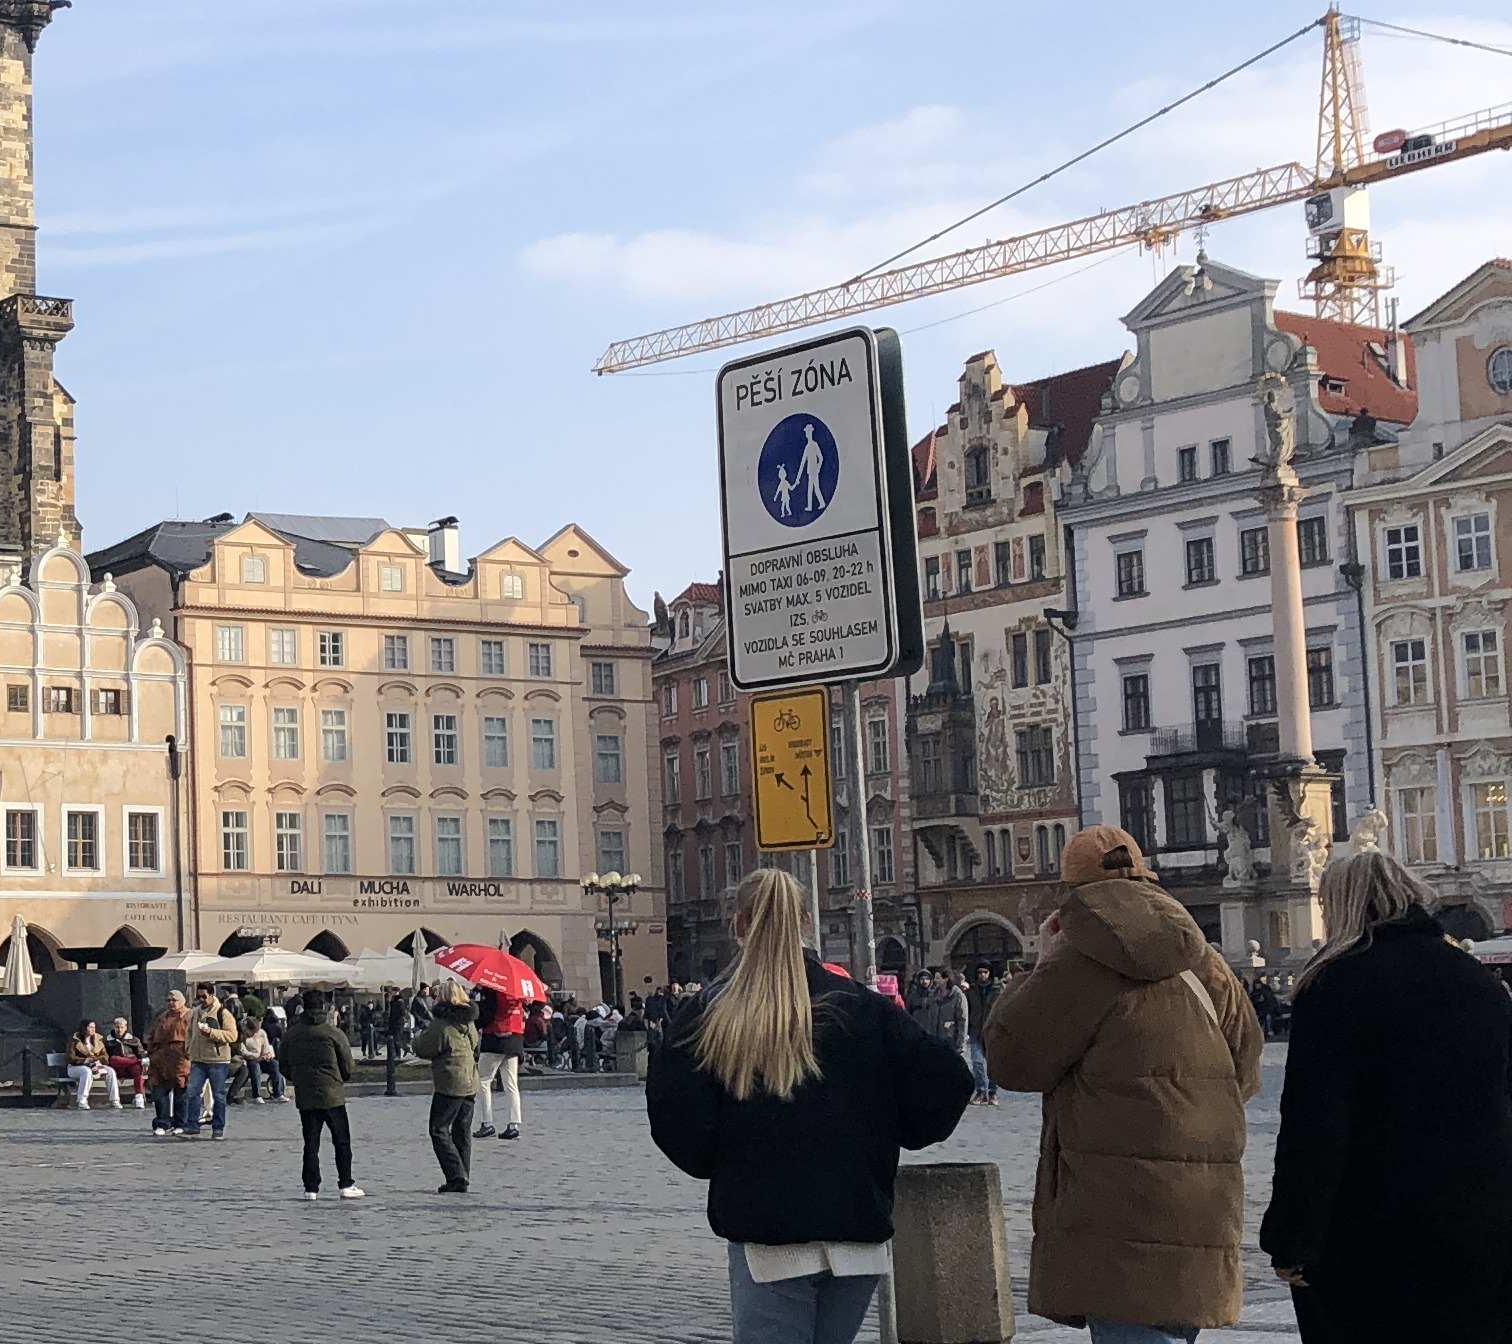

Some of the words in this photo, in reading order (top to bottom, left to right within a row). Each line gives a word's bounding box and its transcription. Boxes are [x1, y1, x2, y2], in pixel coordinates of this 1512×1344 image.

[736, 367, 782, 410] PĚŠÍ
[791, 358, 852, 397] ZÓNA
[750, 550, 803, 576] DOPRAVNÍ
[806, 543, 858, 564] OBSLUHA
[739, 581, 767, 598] MIMO
[770, 575, 793, 591] TAXI
[833, 562, 863, 579] 20-22
[744, 597, 782, 616] SVATBY
[815, 590, 822, 603] 5
[825, 581, 871, 600] VOZIDEL
[744, 636, 789, 654] VOZIDLA
[792, 632, 805, 647] SE
[809, 620, 878, 644] SOUHLASEM
[778, 651, 794, 668] MČ
[798, 647, 836, 666] PRAHA
[839, 646, 844, 659] 1
[353, 896, 420, 908] exhibition
[359, 880, 411, 895] MUCHA
[447, 882, 503, 897] WARHOL
[218, 914, 289, 924] RESTAURANT
